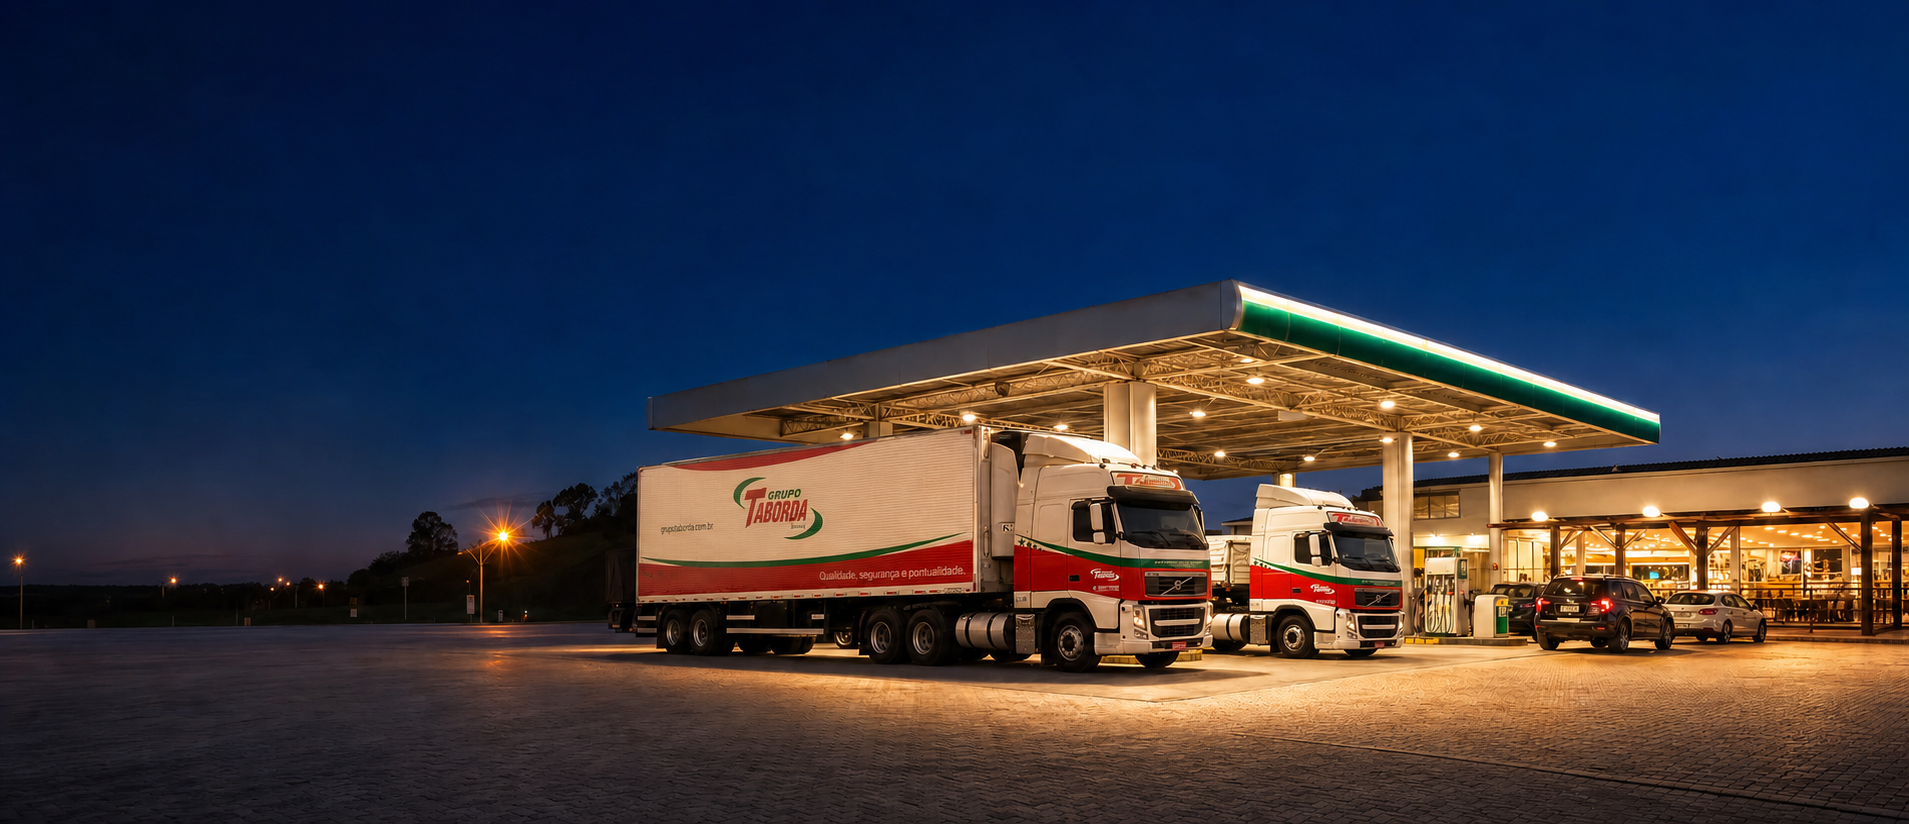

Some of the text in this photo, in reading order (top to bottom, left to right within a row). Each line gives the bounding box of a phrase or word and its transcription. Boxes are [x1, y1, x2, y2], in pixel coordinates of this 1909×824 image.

[768, 489, 802, 500] GRUPO
[744, 487, 808, 528] TABORDA
[819, 565, 967, 581] Qualidade, segurança e pontualidade.
